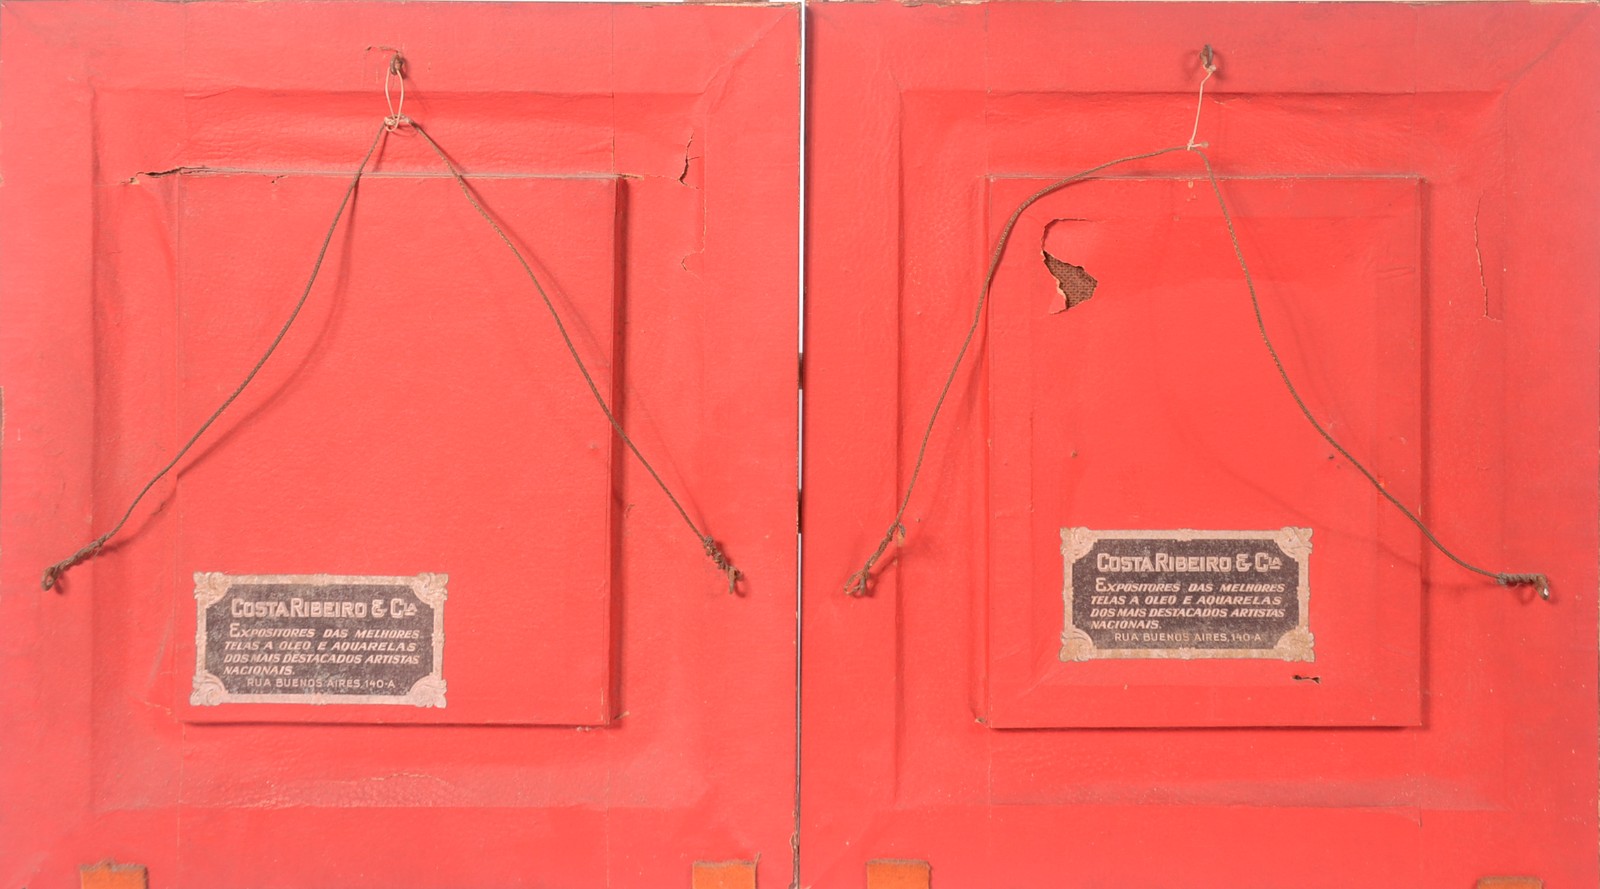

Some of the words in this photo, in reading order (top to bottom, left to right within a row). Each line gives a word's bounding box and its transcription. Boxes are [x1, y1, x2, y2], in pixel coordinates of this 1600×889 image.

[1236, 554, 1252, 572] &
[1096, 578, 1180, 592] EXPOSITORES
[1188, 584, 1213, 592] DAS
[1220, 584, 1285, 592] MELHORES
[1091, 596, 1126, 605] TELAS
[1128, 596, 1139, 605] A
[1145, 596, 1176, 605] OLEO
[1183, 596, 1192, 605] E
[1196, 596, 1282, 606] AQUARELAS
[371, 599, 387, 617] &
[1090, 608, 1116, 617] DOS
[1117, 608, 1146, 617] MAIS
[1149, 608, 1227, 617] DESTACADOS
[1231, 609, 1285, 617] ARTISTAS
[1090, 620, 1161, 629] NACIONAIS.
[229, 623, 315, 638] EXPOSITORES
[323, 629, 348, 638] DAS
[354, 630, 420, 639] MELHORES
[1115, 633, 1138, 641] RUA
[1143, 633, 1189, 641] BUENOS
[224, 641, 260, 650] TELAS
[263, 641, 273, 650] A
[279, 641, 311, 650] OLEO
[318, 642, 327, 650] E
[331, 642, 416, 651] AQUARELAS
[224, 654, 249, 663] DOS
[252, 654, 280, 663] MAIS
[282, 654, 361, 664] DESTACADOS
[364, 655, 420, 664] ARTISTAS
[223, 666, 295, 675] NACIONAIS.
[276, 679, 322, 688] BUENOS
